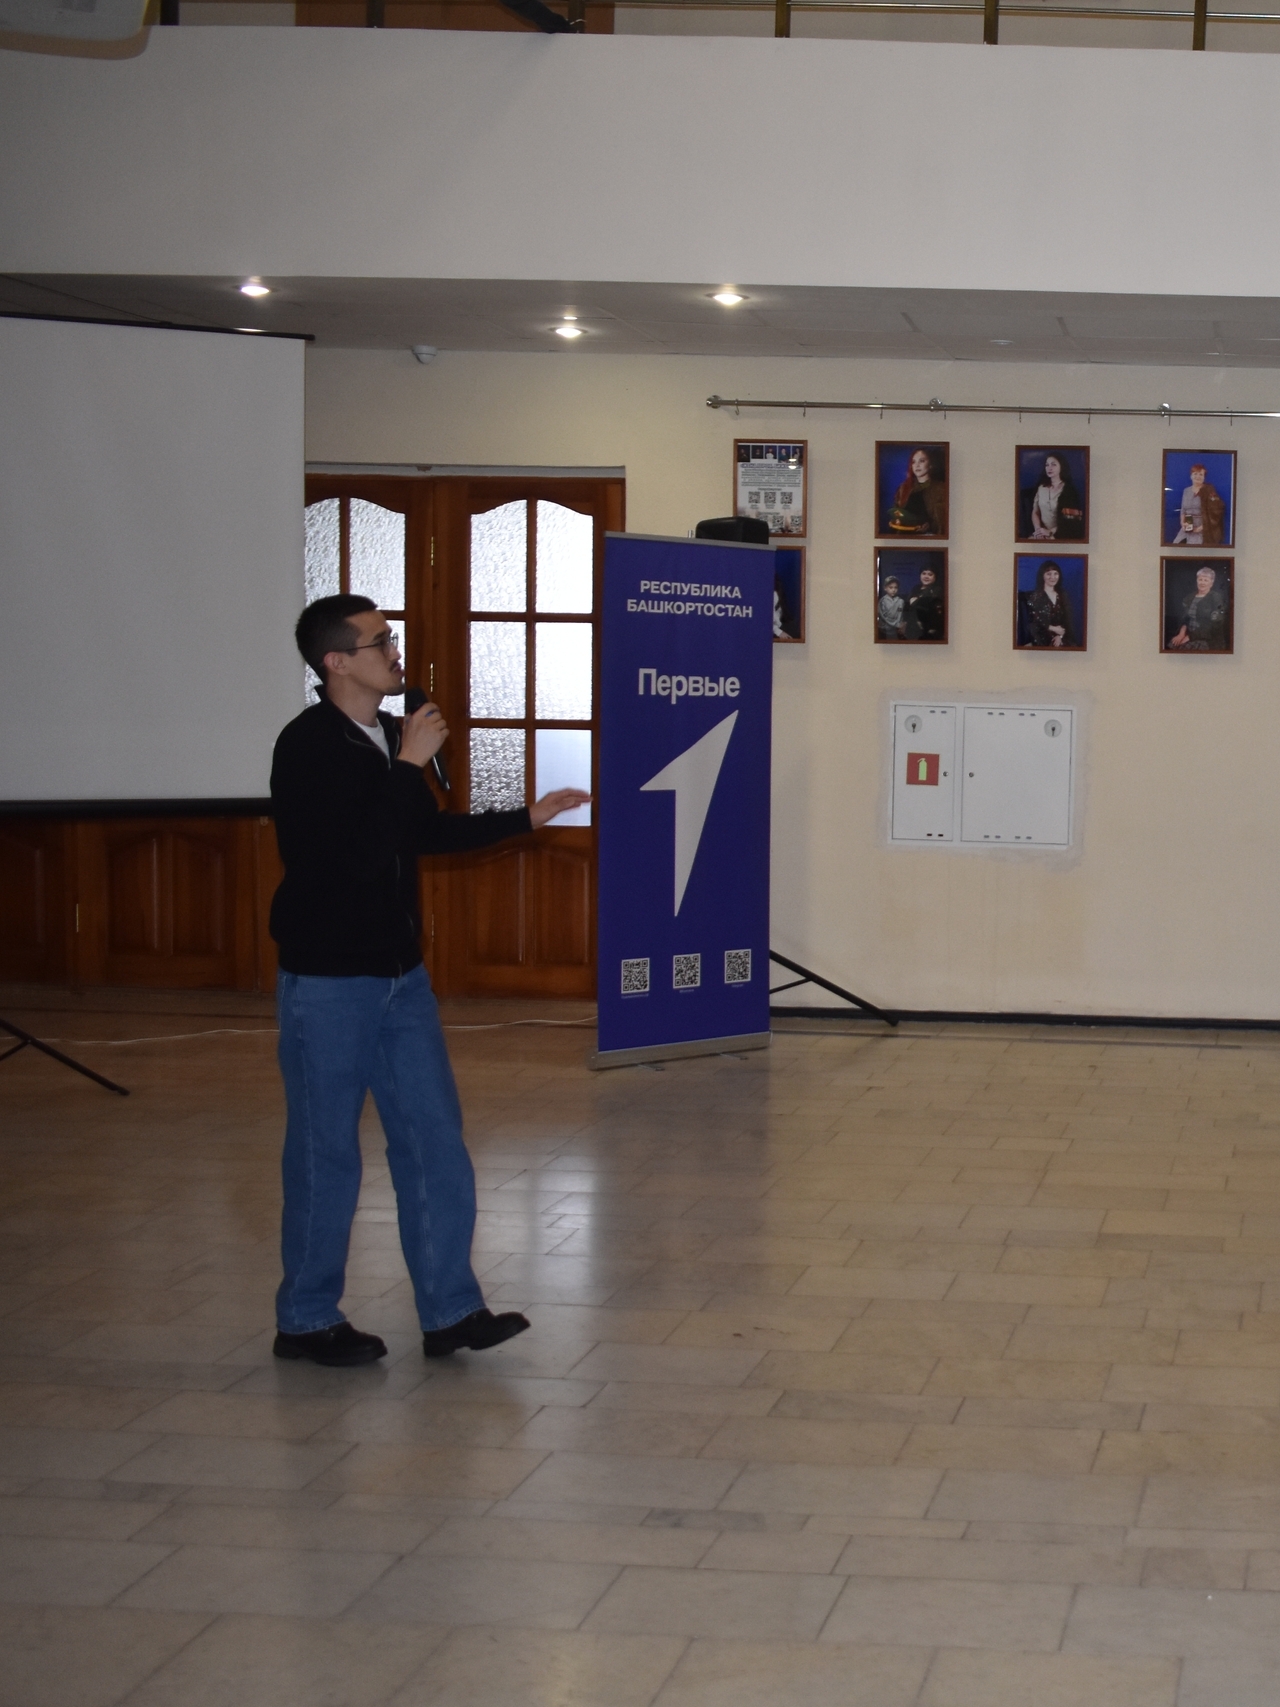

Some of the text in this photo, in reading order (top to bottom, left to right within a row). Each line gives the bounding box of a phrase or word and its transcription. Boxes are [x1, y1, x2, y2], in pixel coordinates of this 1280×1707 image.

[640, 580, 742, 598] РЕСПУБЛИКА
[627, 599, 752, 618] БАШКОРТОСТАН
[638, 668, 741, 705] Первые
